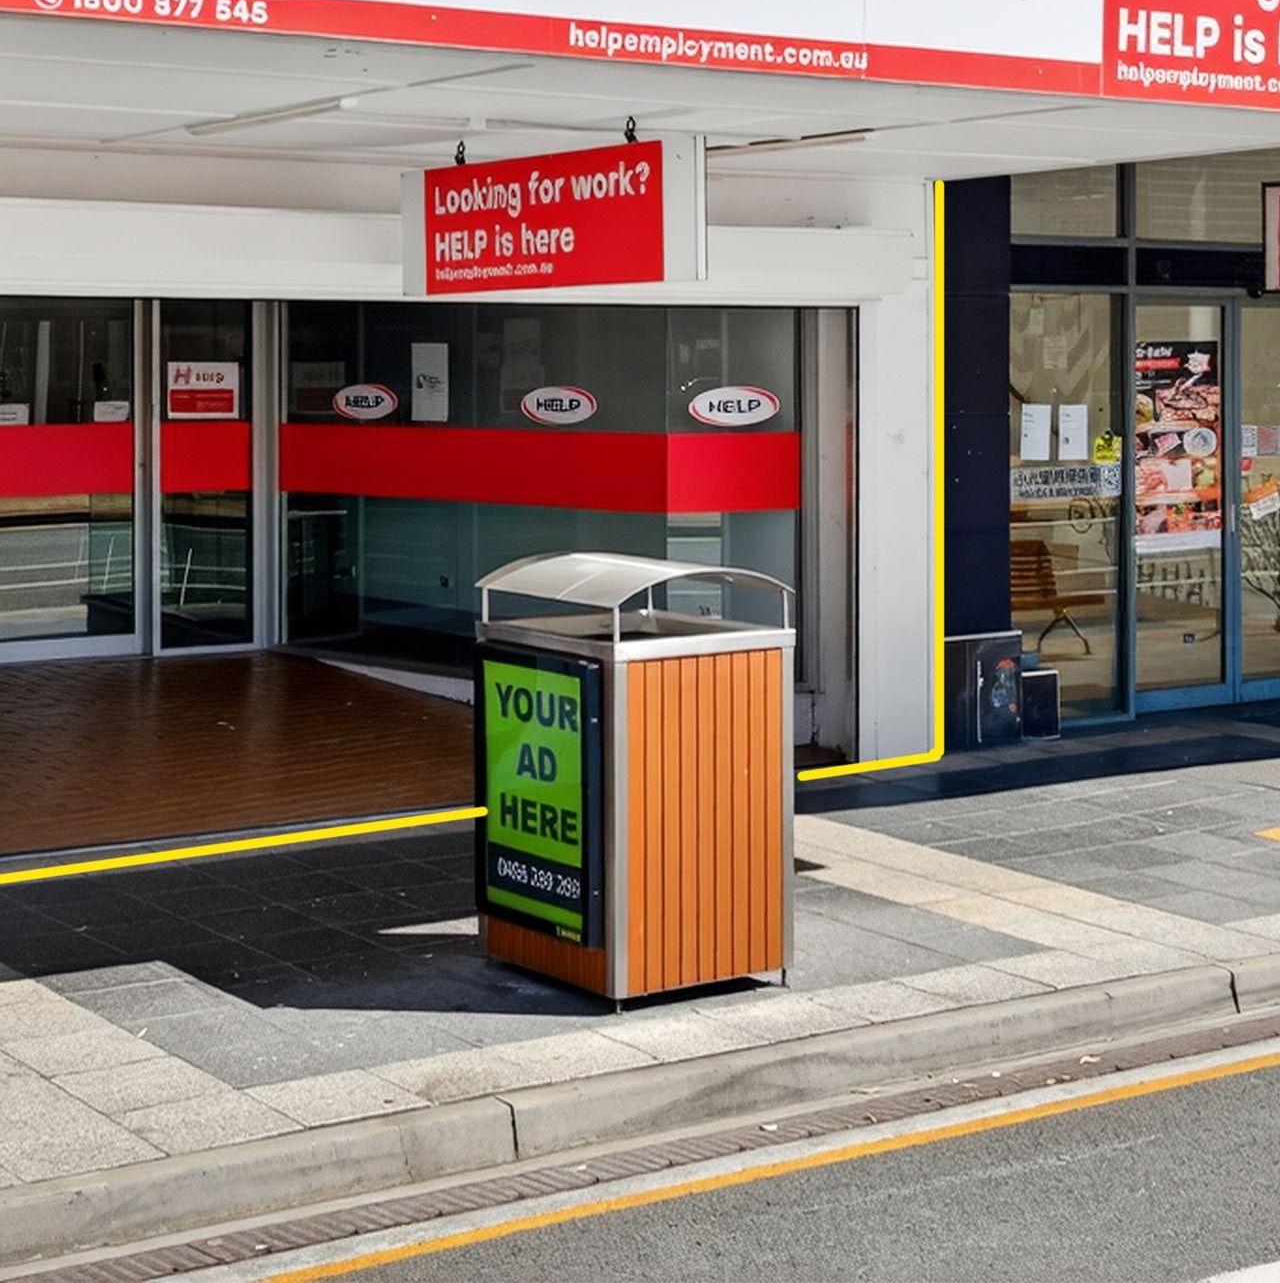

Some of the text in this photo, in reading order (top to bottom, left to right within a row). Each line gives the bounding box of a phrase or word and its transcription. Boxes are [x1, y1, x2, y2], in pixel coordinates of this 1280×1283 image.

[569, 21, 868, 71] helpemployment.com.au
[1118, 7, 1221, 59] HELP
[1233, 14, 1267, 65] is
[434, 160, 650, 218] Looking for work?
[435, 222, 575, 263] HELP is here
[495, 681, 579, 734] YOUR
[516, 743, 557, 783] AD
[499, 791, 580, 847] HERE
